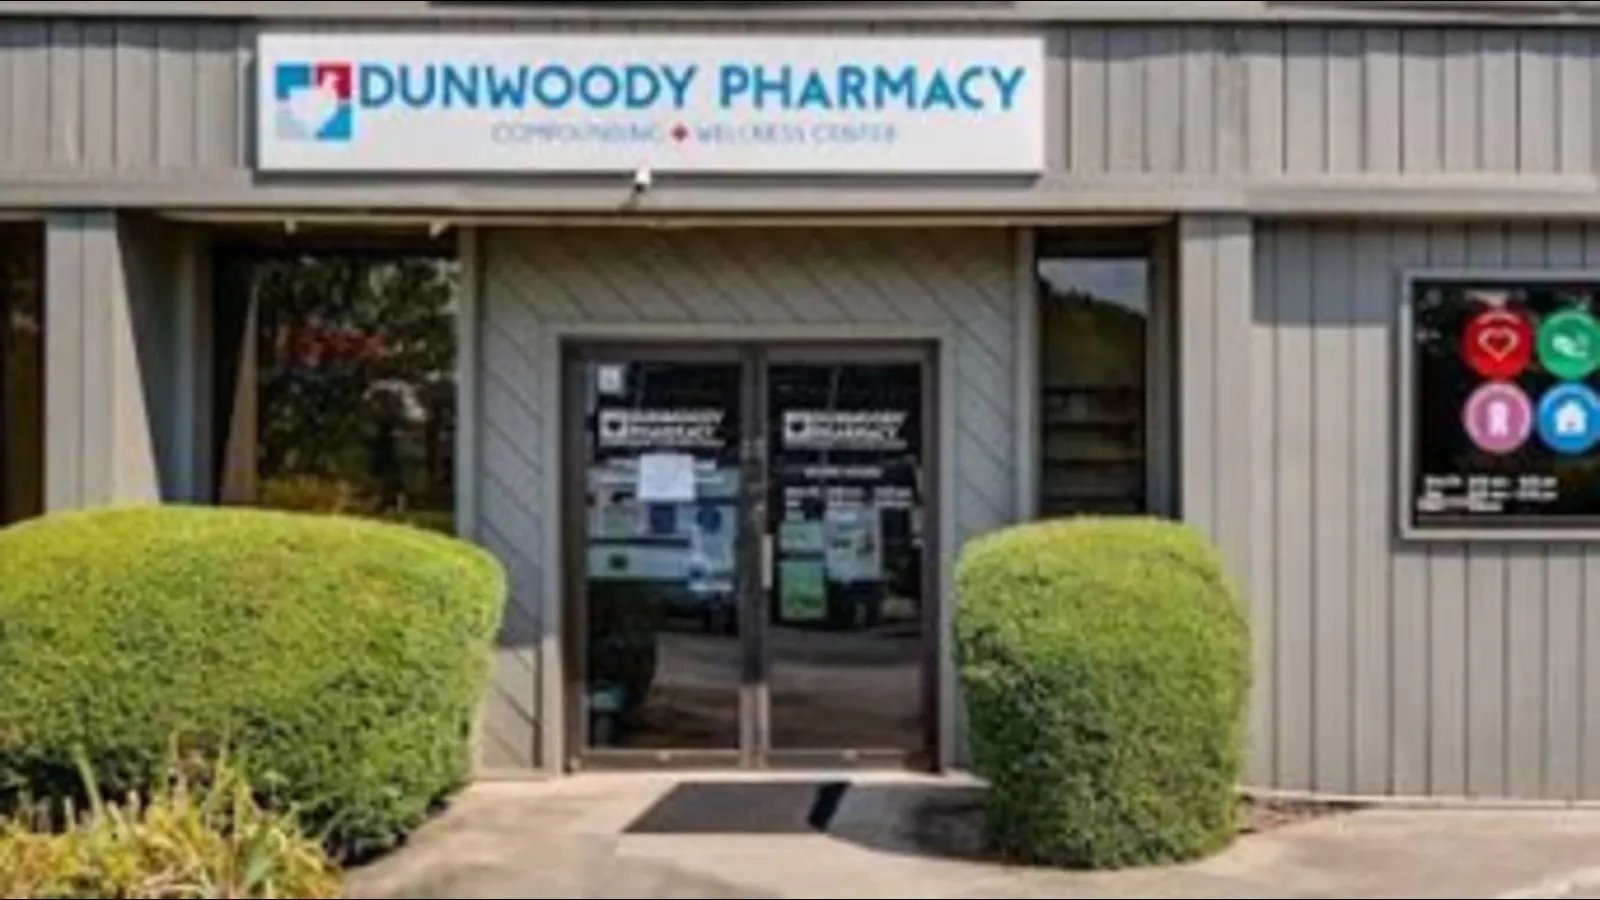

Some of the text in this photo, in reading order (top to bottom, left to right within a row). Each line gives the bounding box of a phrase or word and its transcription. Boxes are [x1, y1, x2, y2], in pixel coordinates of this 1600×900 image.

[358, 64, 1025, 109] DUNWOODY PHARMACY
[811, 121, 898, 143] CENTER
